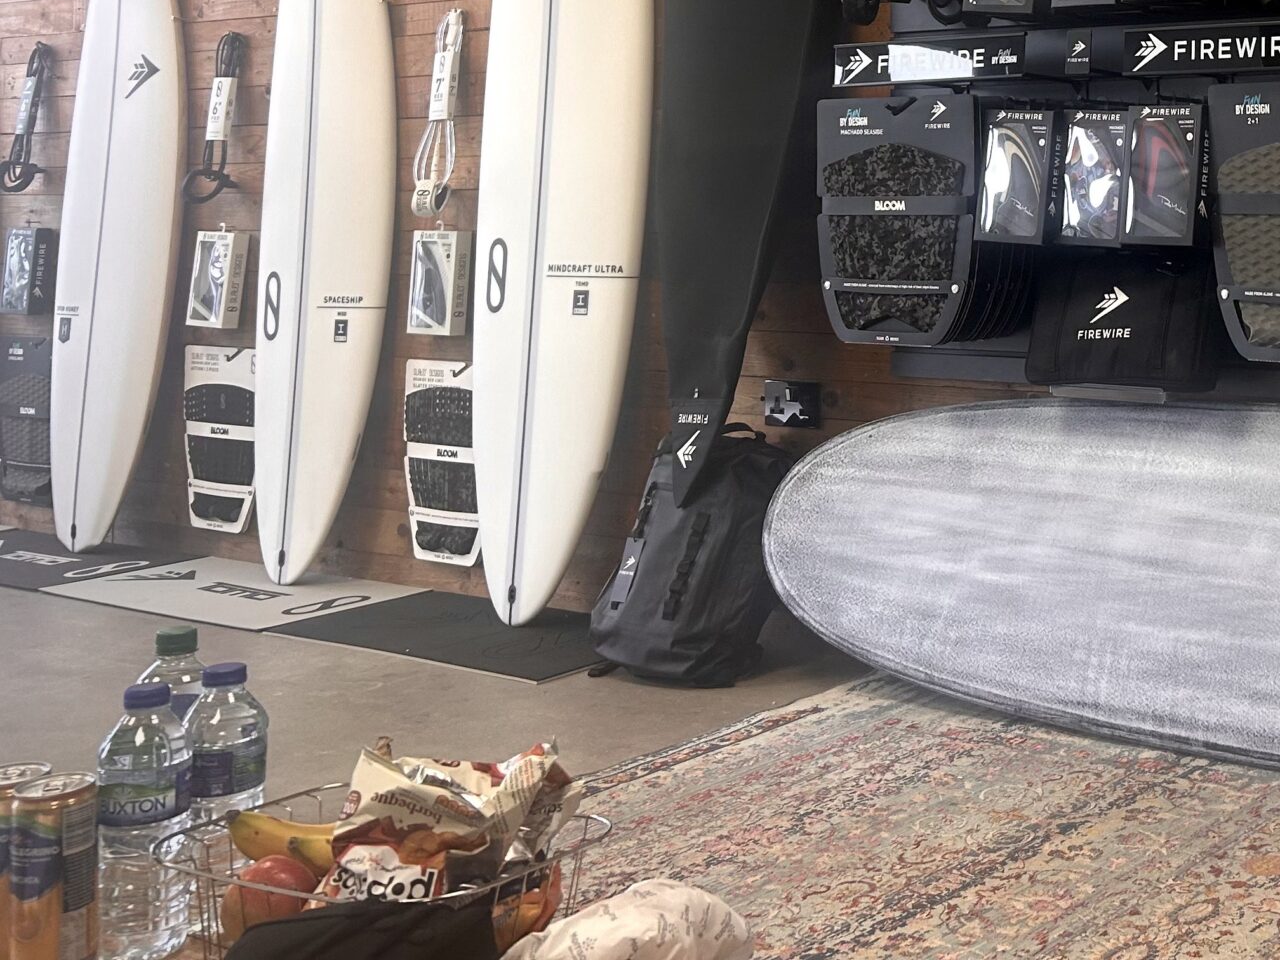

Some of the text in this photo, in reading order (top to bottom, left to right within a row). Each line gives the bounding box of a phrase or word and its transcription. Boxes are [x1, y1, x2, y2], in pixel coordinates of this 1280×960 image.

[991, 55, 1018, 65] BY DESIGN
[1243, 93, 1261, 106] FUN
[846, 107, 861, 120] FUN
[1152, 107, 1191, 116] FIREWIRE
[1235, 103, 1270, 115] BY DESIGN
[839, 116, 868, 127] BY DESIGN
[1007, 112, 1043, 121] FIREWIRE
[1084, 112, 1121, 121] FIREWIRE
[1247, 117, 1259, 125] 2+1
[1051, 134, 1062, 198] FIREWIRE
[1200, 130, 1209, 197] FIREWIRE
[874, 200, 906, 211] BLOOM
[35, 243, 47, 285] FIREWIRE
[547, 263, 624, 274] MINDCRAFT ULTRA
[323, 295, 364, 304] SPACESHIP
[1077, 327, 1132, 340] FIREWIRE
[678, 413, 709, 425] FIREWIRE
[210, 426, 229, 436] BLOOM
[436, 448, 458, 459] BLOOM
